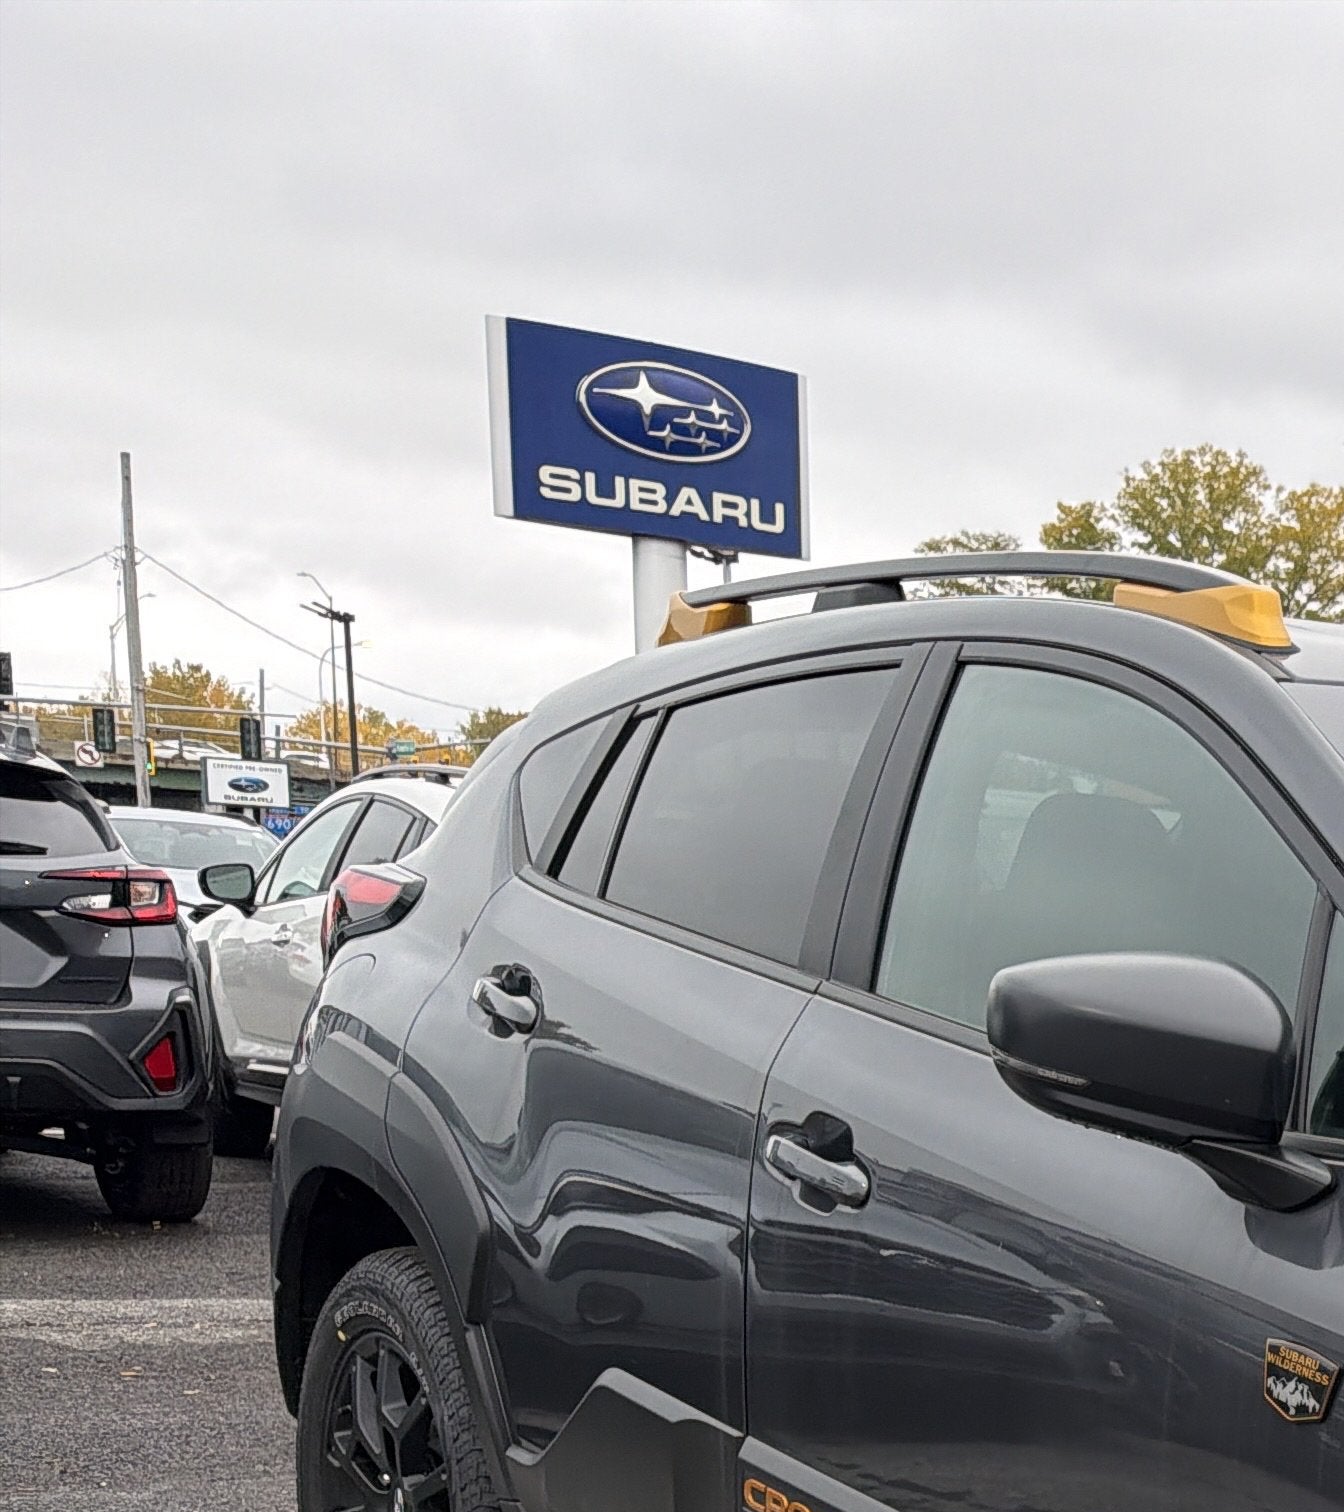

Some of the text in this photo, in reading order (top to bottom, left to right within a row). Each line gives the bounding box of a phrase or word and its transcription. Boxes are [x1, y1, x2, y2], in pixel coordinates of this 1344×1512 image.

[537, 464, 785, 534] SUBARU
[223, 794, 274, 804] SUBARU
[267, 818, 292, 830] 690
[1267, 1351, 1330, 1386] WILDERNESS
[1278, 1345, 1321, 1371] SUBARU
